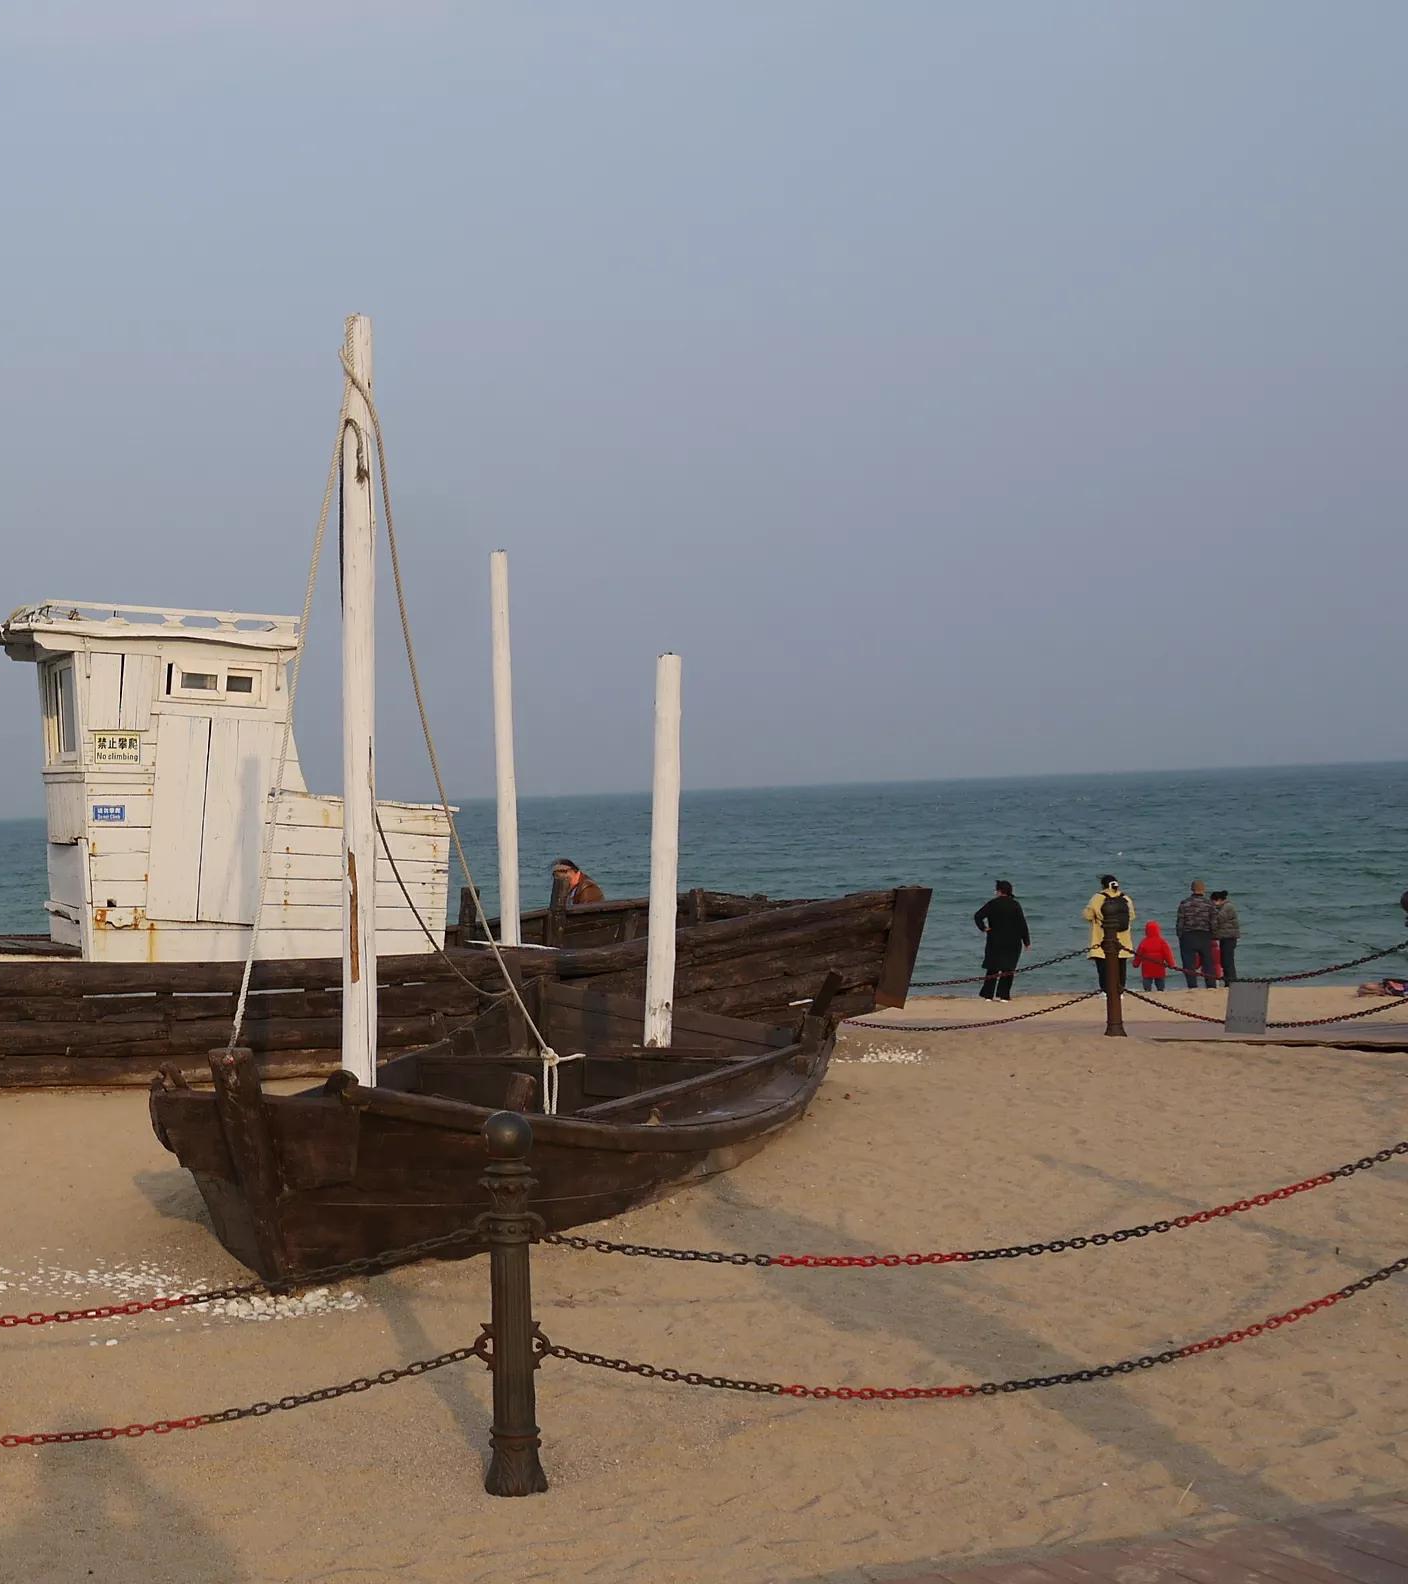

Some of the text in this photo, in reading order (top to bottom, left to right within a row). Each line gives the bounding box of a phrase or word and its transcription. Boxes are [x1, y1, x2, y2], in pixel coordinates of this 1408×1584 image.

[97, 736, 138, 750] 禁止攀爬
[96, 752, 107, 760] No
